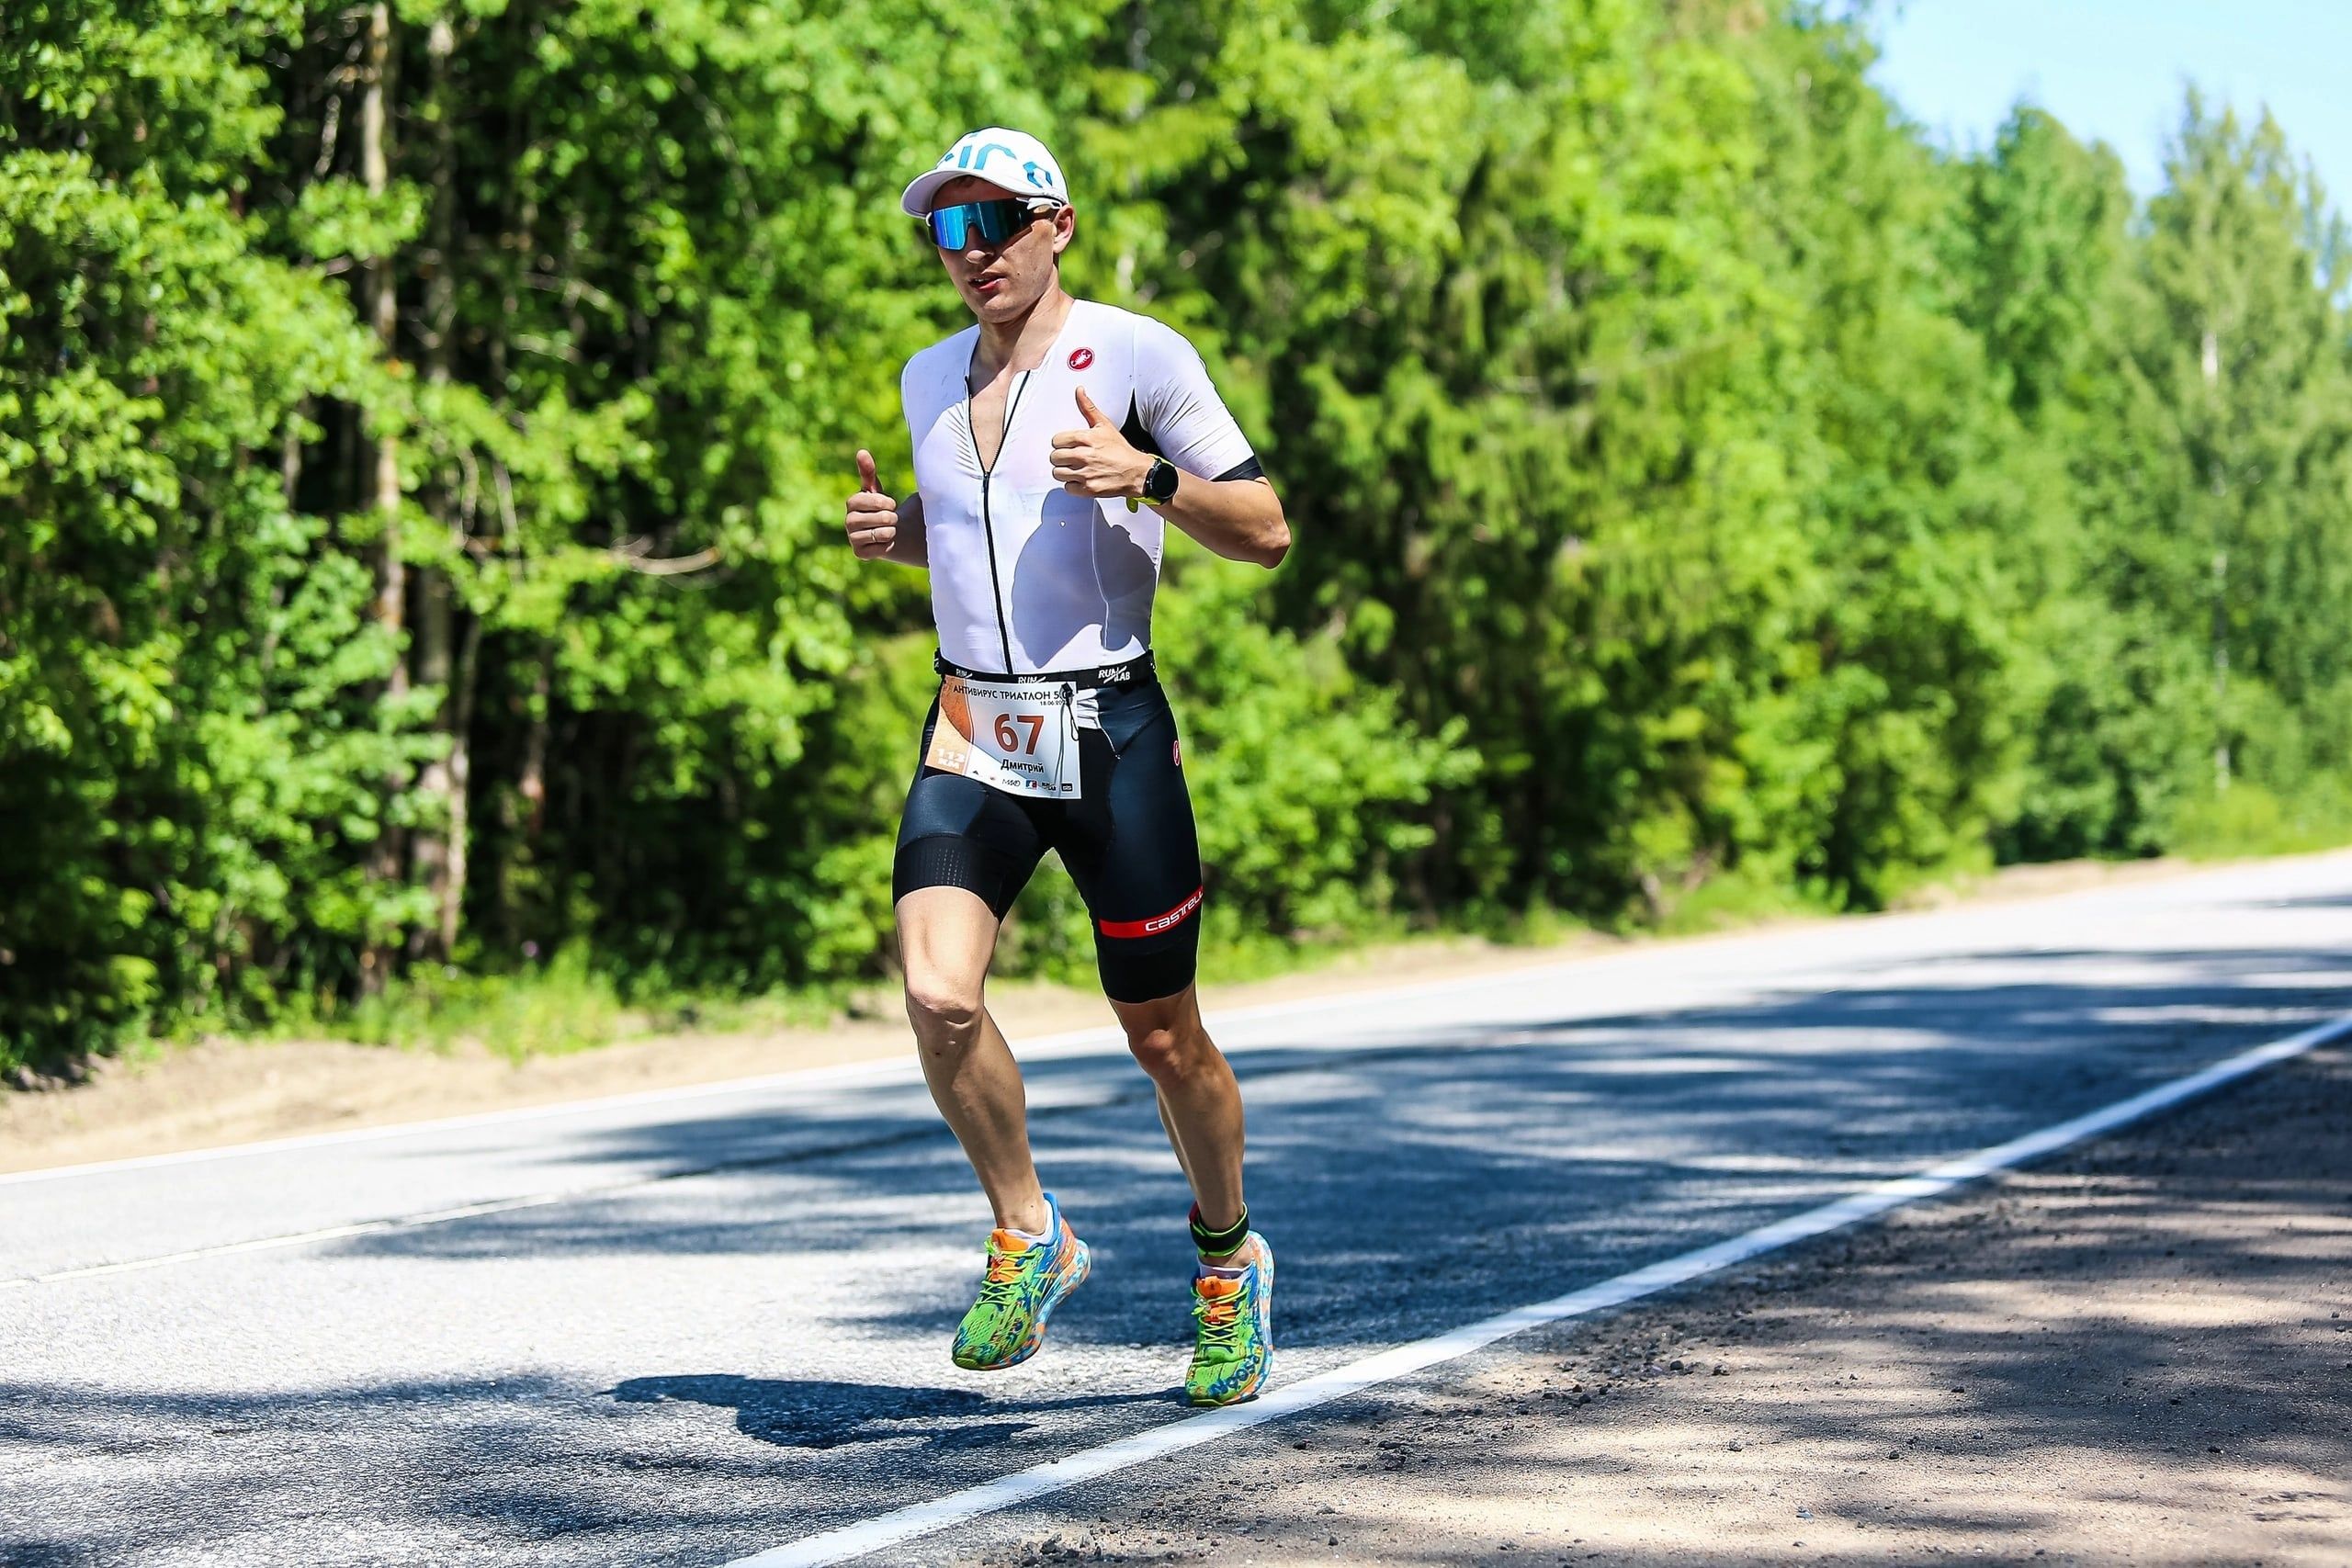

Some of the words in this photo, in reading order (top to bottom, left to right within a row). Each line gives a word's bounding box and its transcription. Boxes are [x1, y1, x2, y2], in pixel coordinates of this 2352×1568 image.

[1098, 667, 1119, 679] RUN
[953, 684, 998, 699] АНТИВИРУС
[1000, 690, 1051, 701] ТРИАТЛОН
[994, 713, 1045, 755] 67
[1001, 759, 1045, 773] Дмитрий
